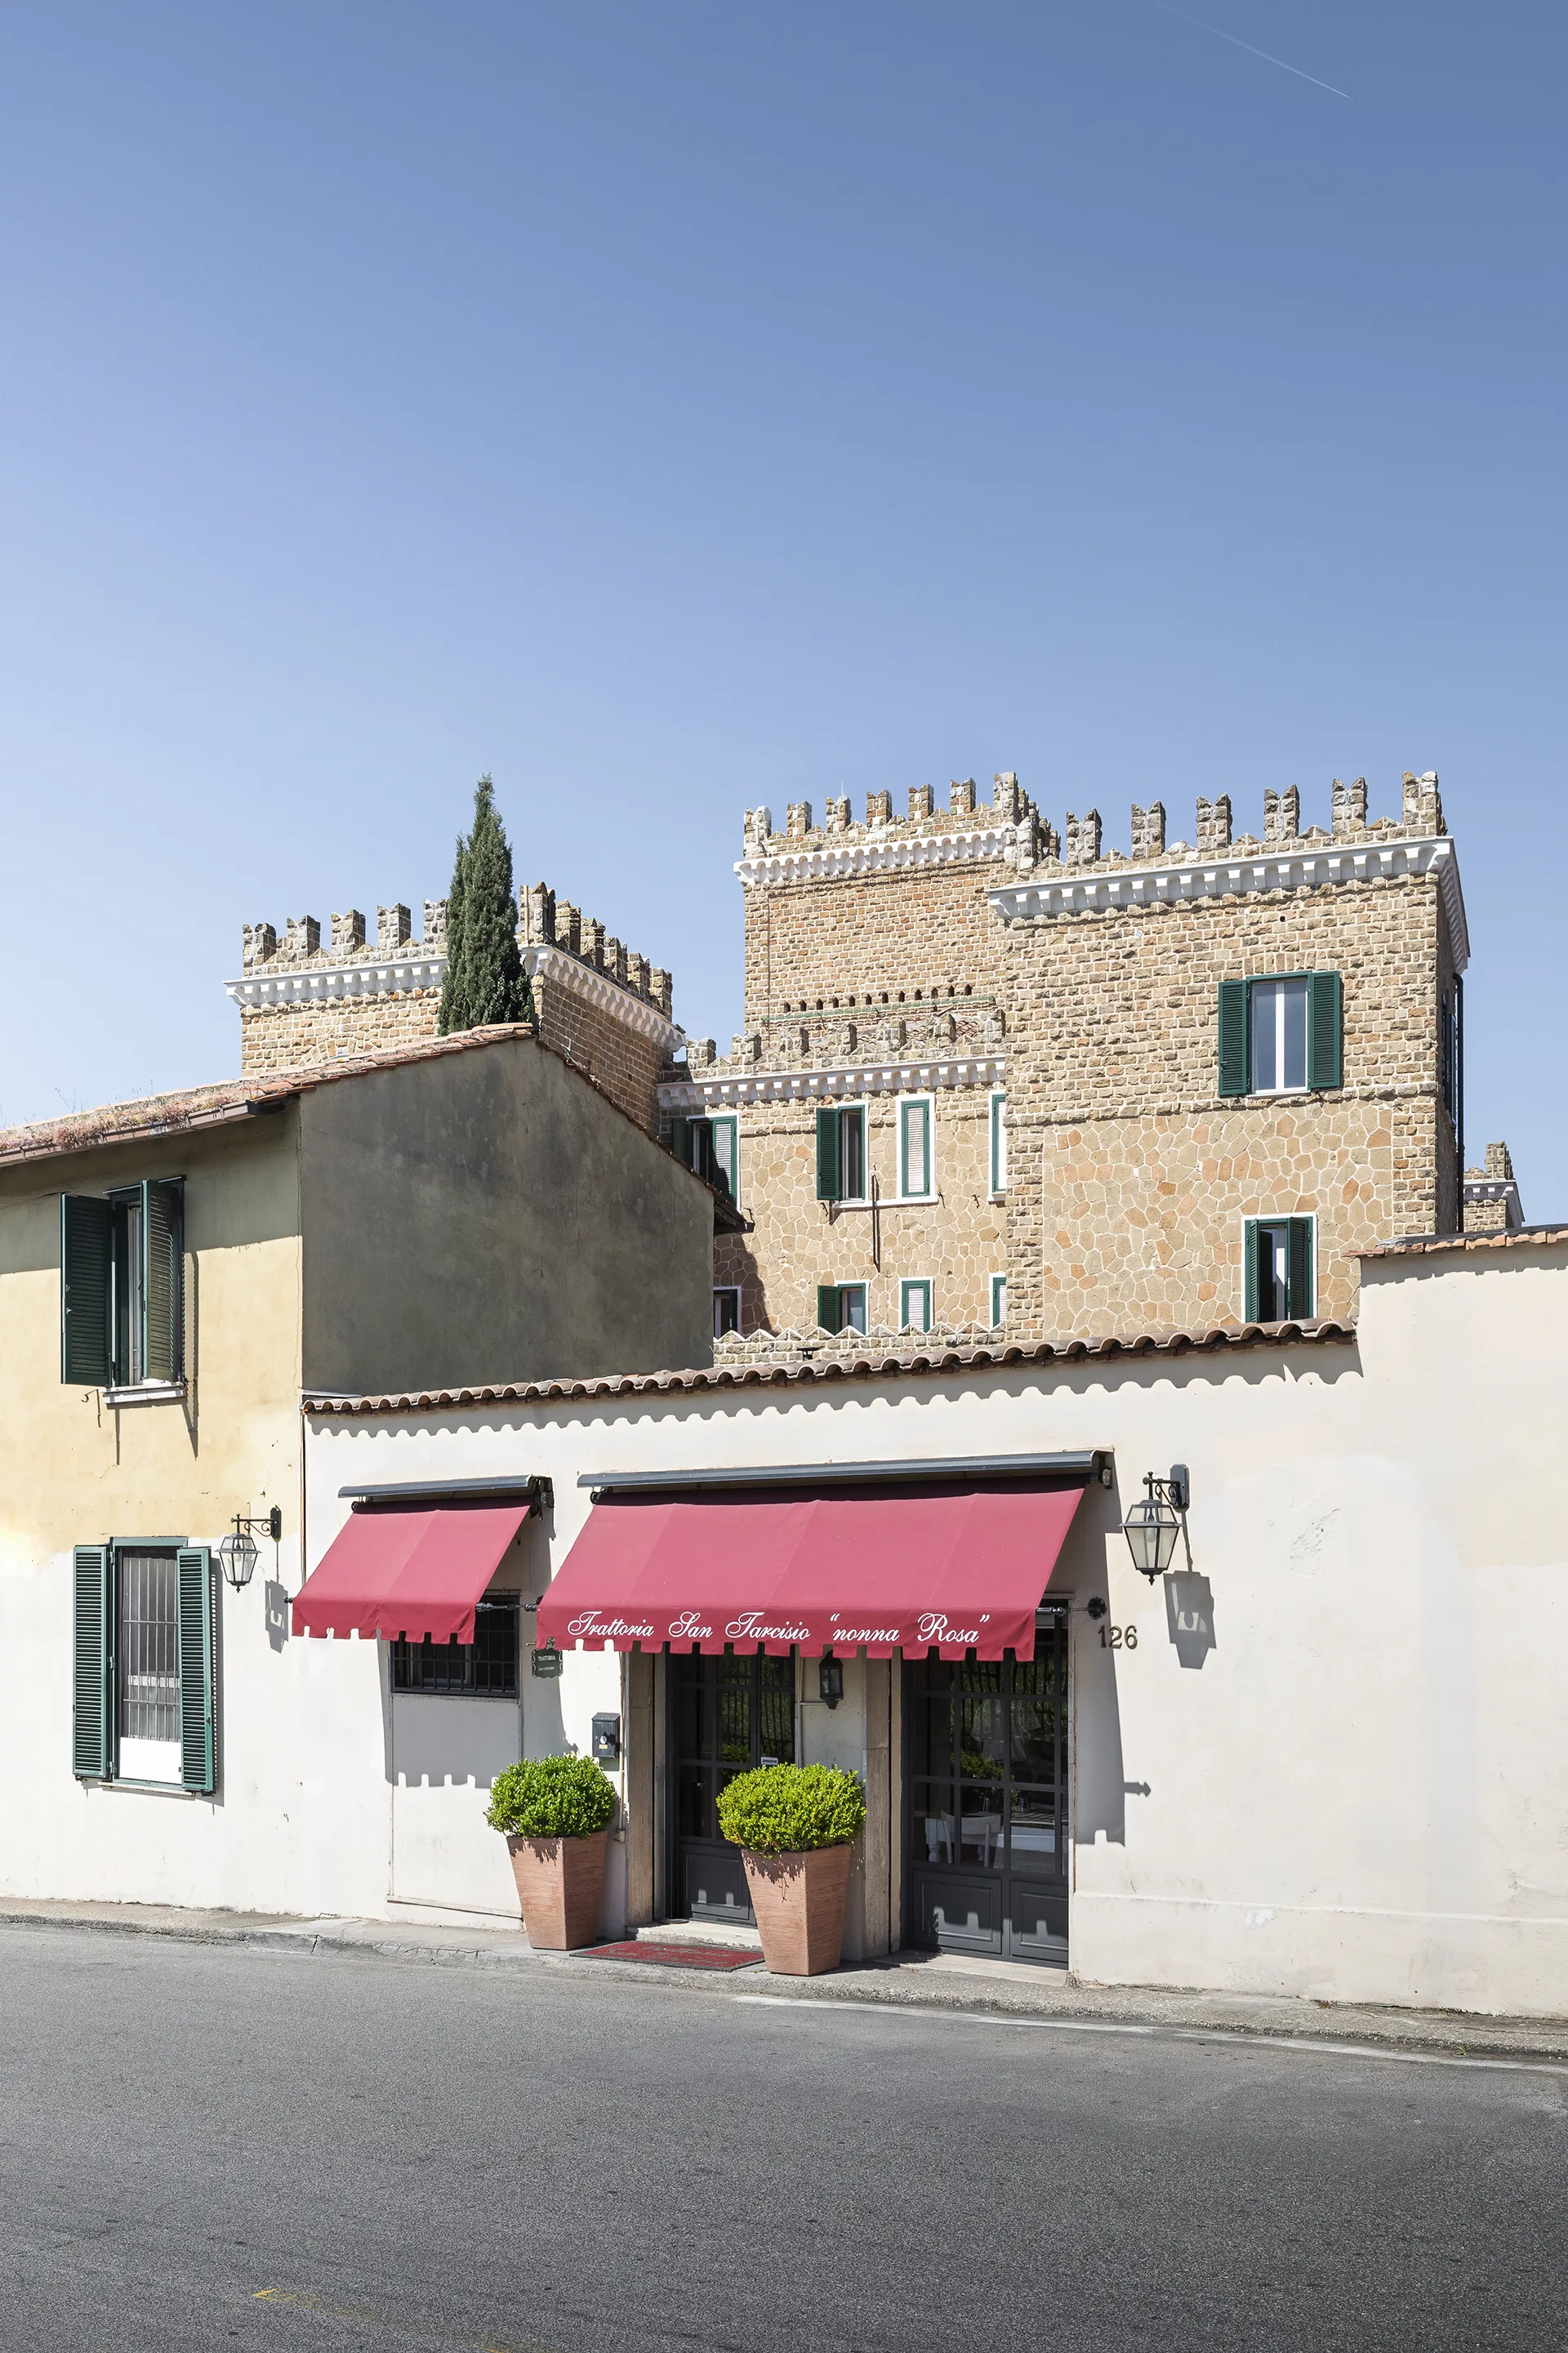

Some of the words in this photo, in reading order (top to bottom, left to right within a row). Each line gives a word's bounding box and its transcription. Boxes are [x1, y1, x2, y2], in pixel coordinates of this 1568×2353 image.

[568, 1611, 654, 1637] Trattoria
[669, 1611, 713, 1638] San
[725, 1612, 811, 1639] Tarcisio
[1098, 1624, 1138, 1650] 126
